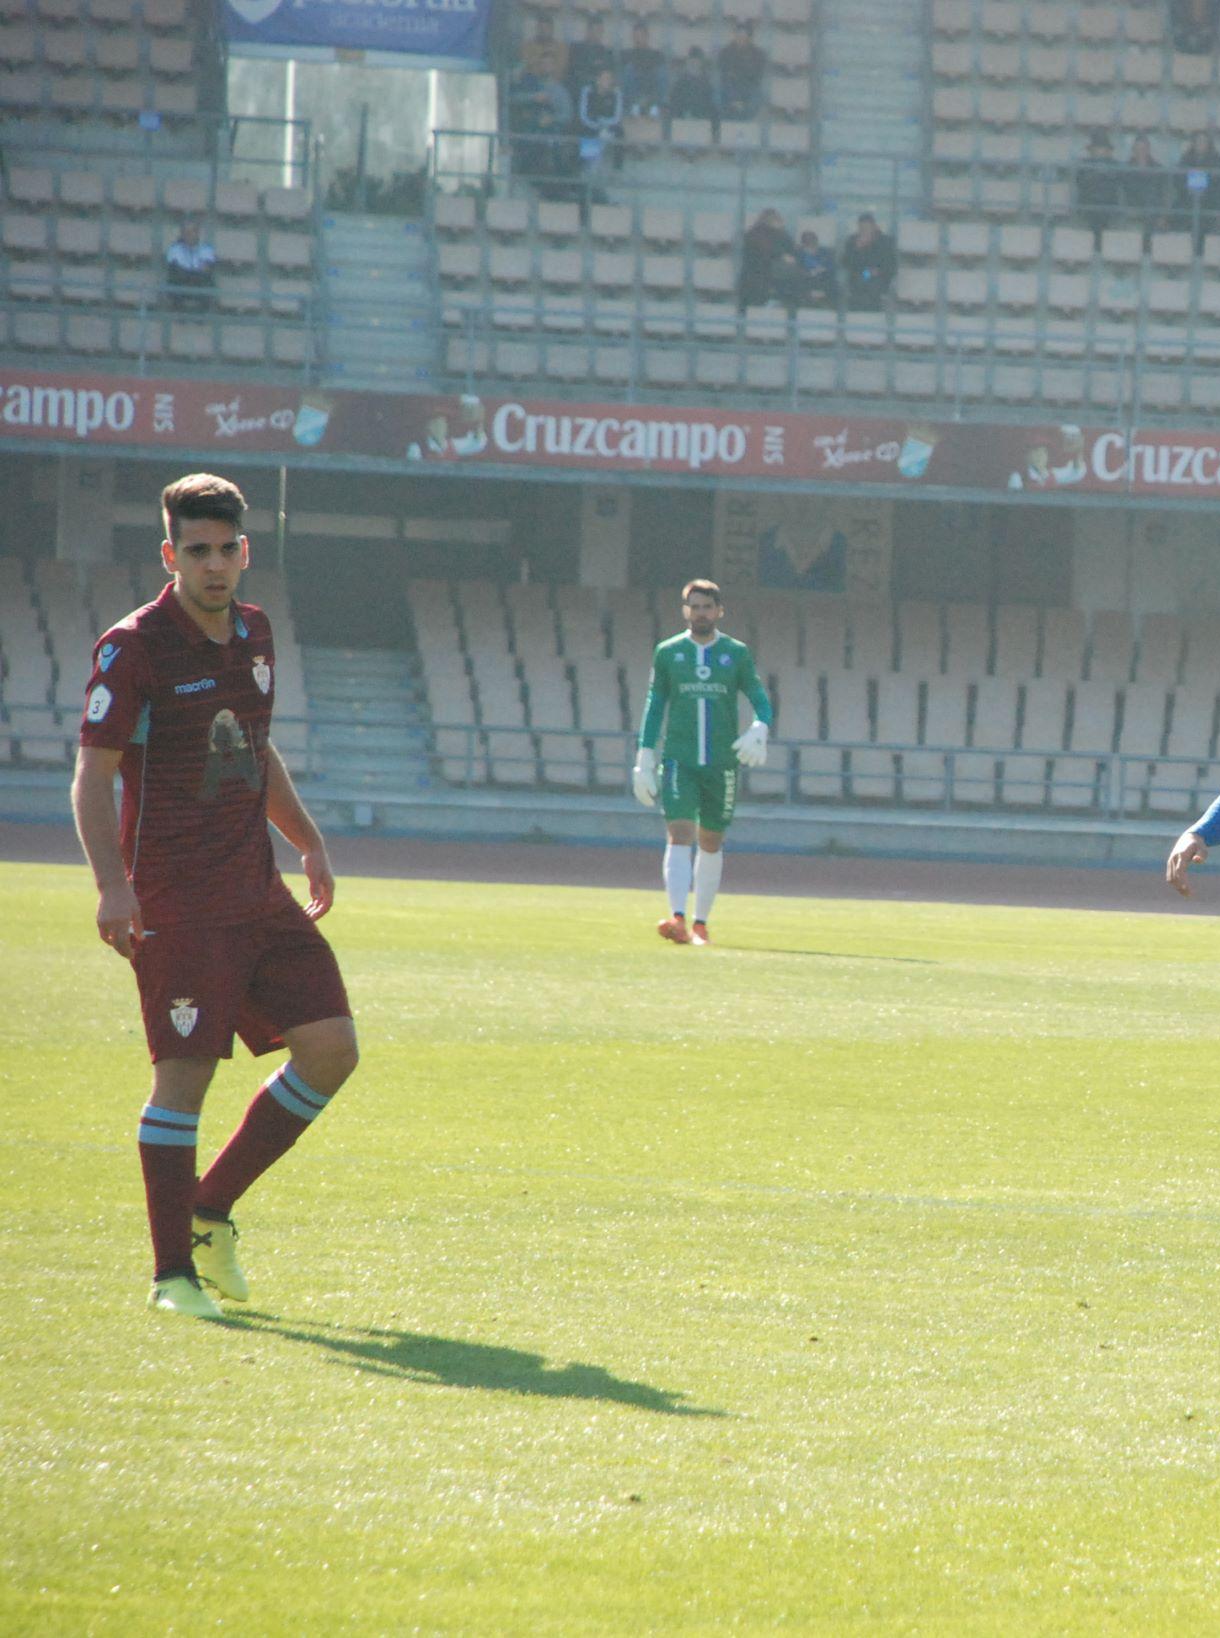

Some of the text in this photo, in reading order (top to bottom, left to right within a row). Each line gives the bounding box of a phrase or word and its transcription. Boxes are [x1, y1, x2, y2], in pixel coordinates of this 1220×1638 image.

[0, 384, 134, 438] ampo
[153, 393, 174, 432] SIN
[493, 403, 747, 468] Cruzcampo
[763, 425, 784, 465] SIN
